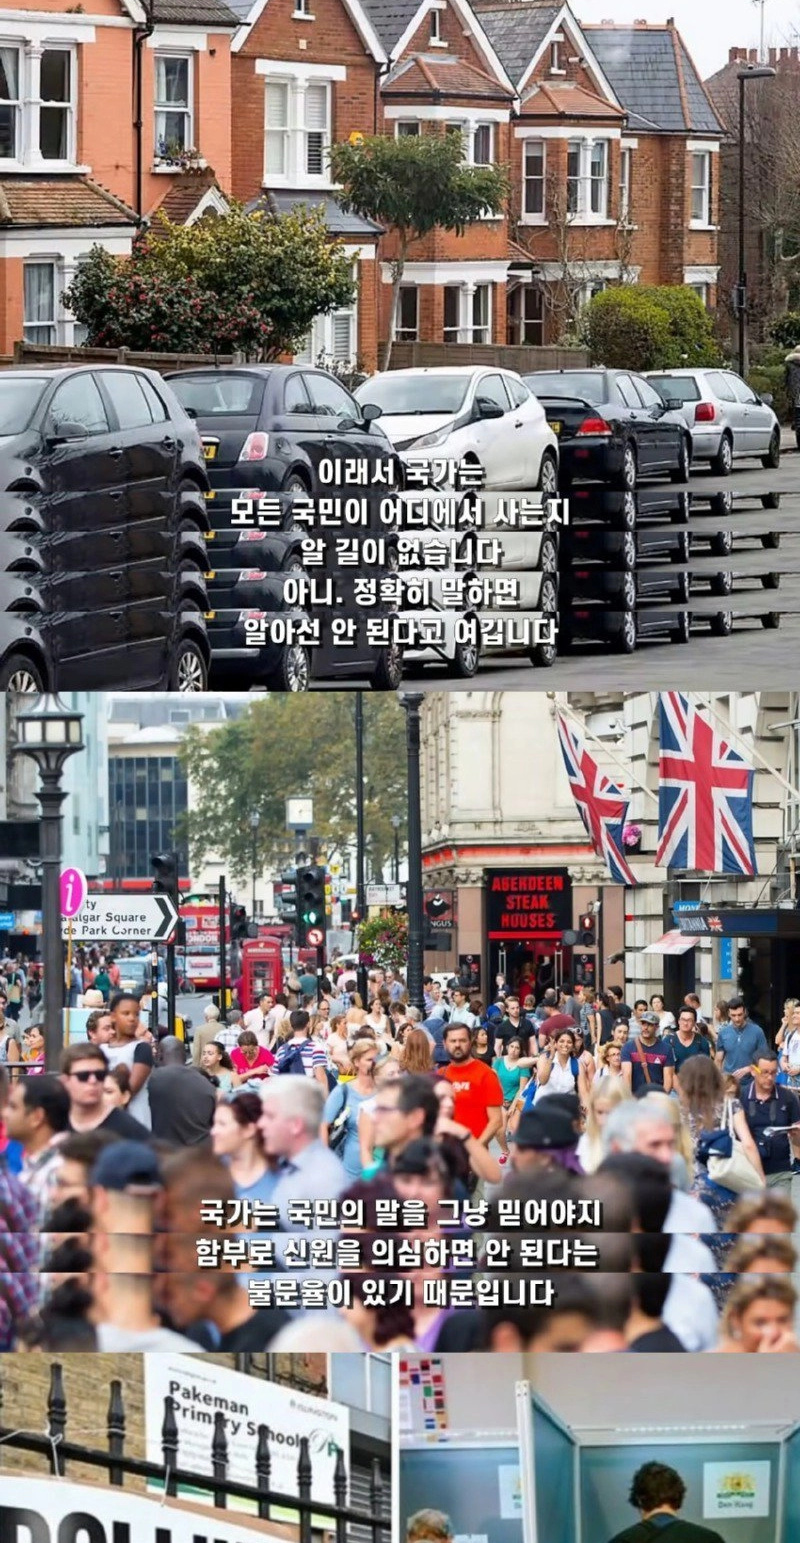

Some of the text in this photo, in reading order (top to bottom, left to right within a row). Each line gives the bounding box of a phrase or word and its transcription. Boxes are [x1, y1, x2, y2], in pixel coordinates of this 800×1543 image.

[491, 876, 564, 892] ABERDEEN
[506, 895, 549, 910] STEAK
[105, 912, 147, 924] Square
[501, 913, 555, 928] HOUSES
[82, 926, 108, 936] Park
[112, 926, 152, 936] Corner
[168, 1380, 250, 1416] Pakeman
[170, 1400, 301, 1448] Primry Shool
